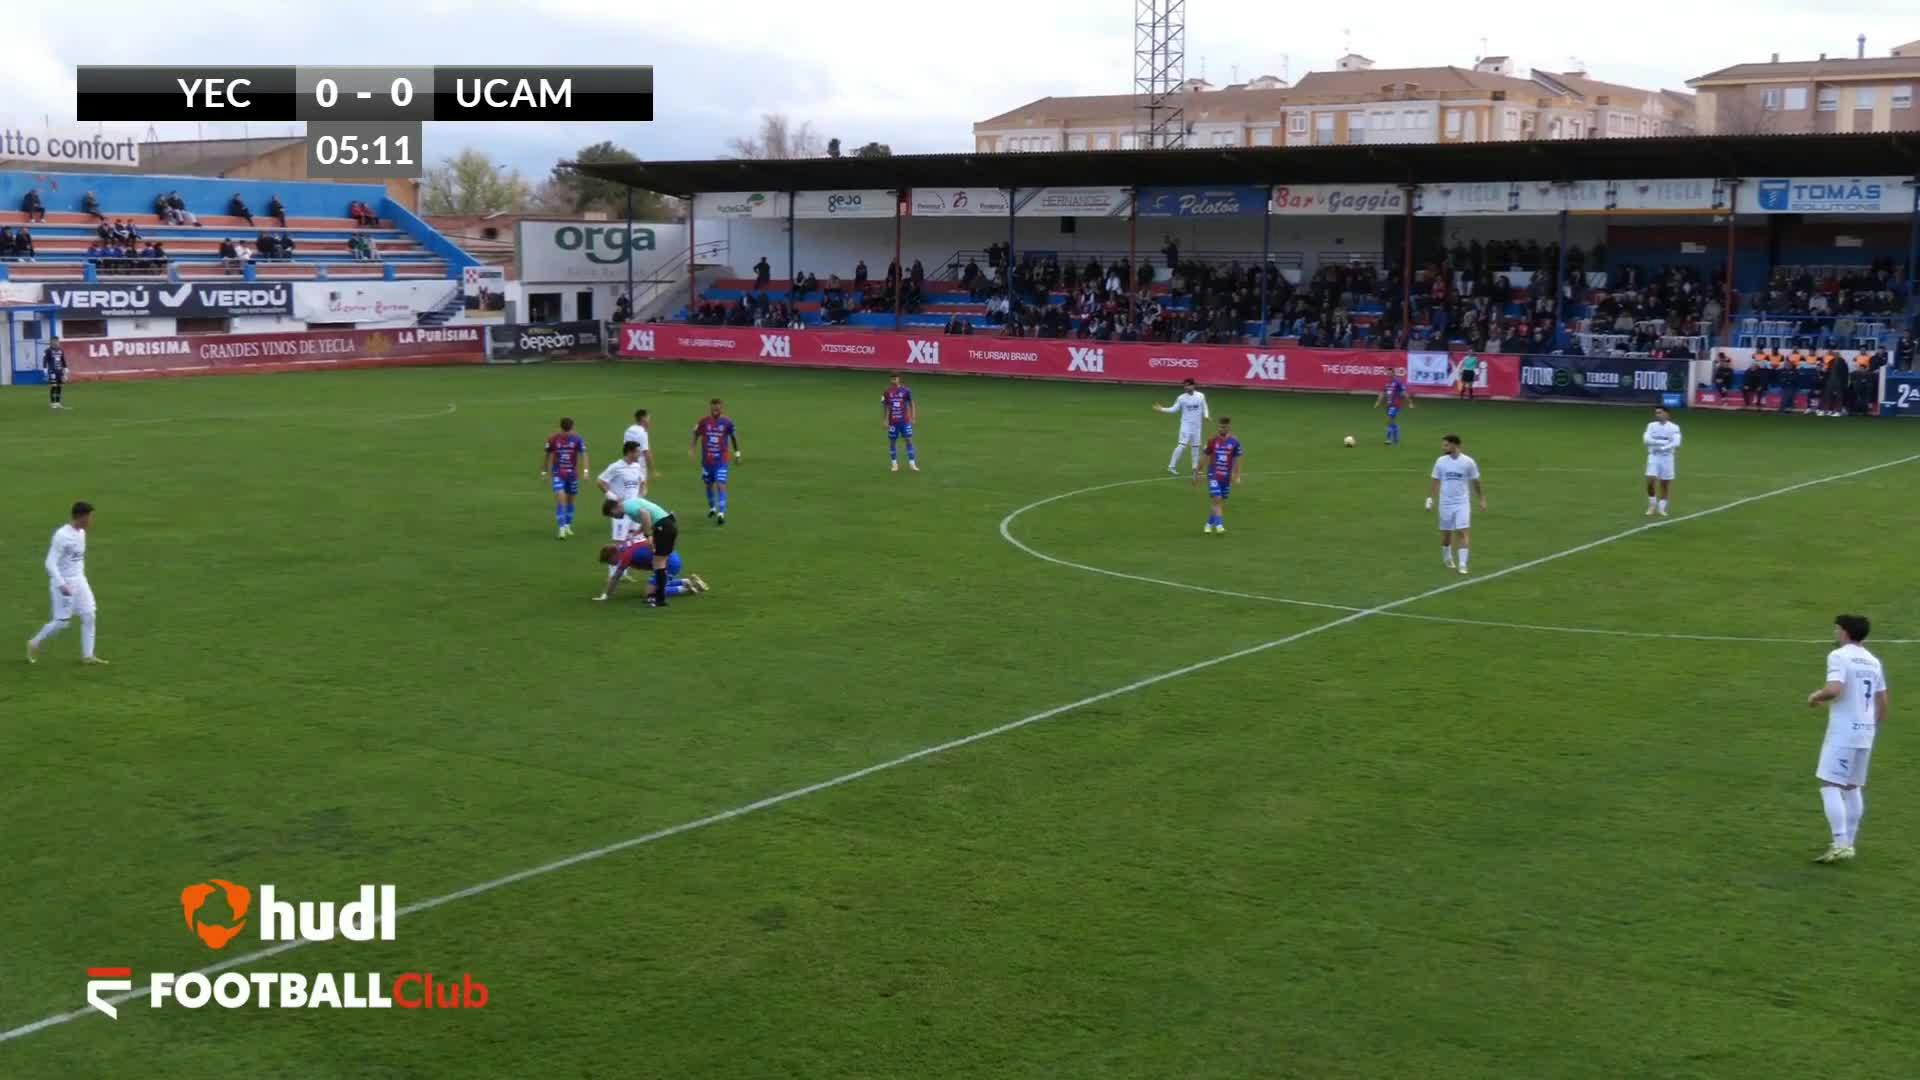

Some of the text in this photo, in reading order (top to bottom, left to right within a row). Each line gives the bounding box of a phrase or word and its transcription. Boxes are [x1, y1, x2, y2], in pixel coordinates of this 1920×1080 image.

[47, 134, 136, 161] confort
[1275, 187, 1400, 213] Bar Gaggia
[1792, 178, 1881, 200] TOMÁS
[1179, 194, 1240, 215] Pelotón
[555, 226, 657, 264] orga
[50, 286, 149, 308] VERDÚ
[199, 284, 287, 307] VERDÚ
[398, 331, 415, 344] LA
[519, 332, 575, 351] depedro
[627, 329, 655, 351] Xti
[759, 334, 792, 358] Xti
[89, 344, 107, 357] LA
[200, 338, 355, 360] GRANDES VINOS DE YECLA
[906, 340, 941, 365] Xti
[969, 350, 1038, 361] THE URBAN BRAND
[1067, 347, 1105, 373] Xti
[1148, 358, 1199, 368] @XTISHOES
[1245, 353, 1287, 381] Xti
[1321, 364, 1339, 374] THE
[1340, 365, 1372, 375] URBAN
